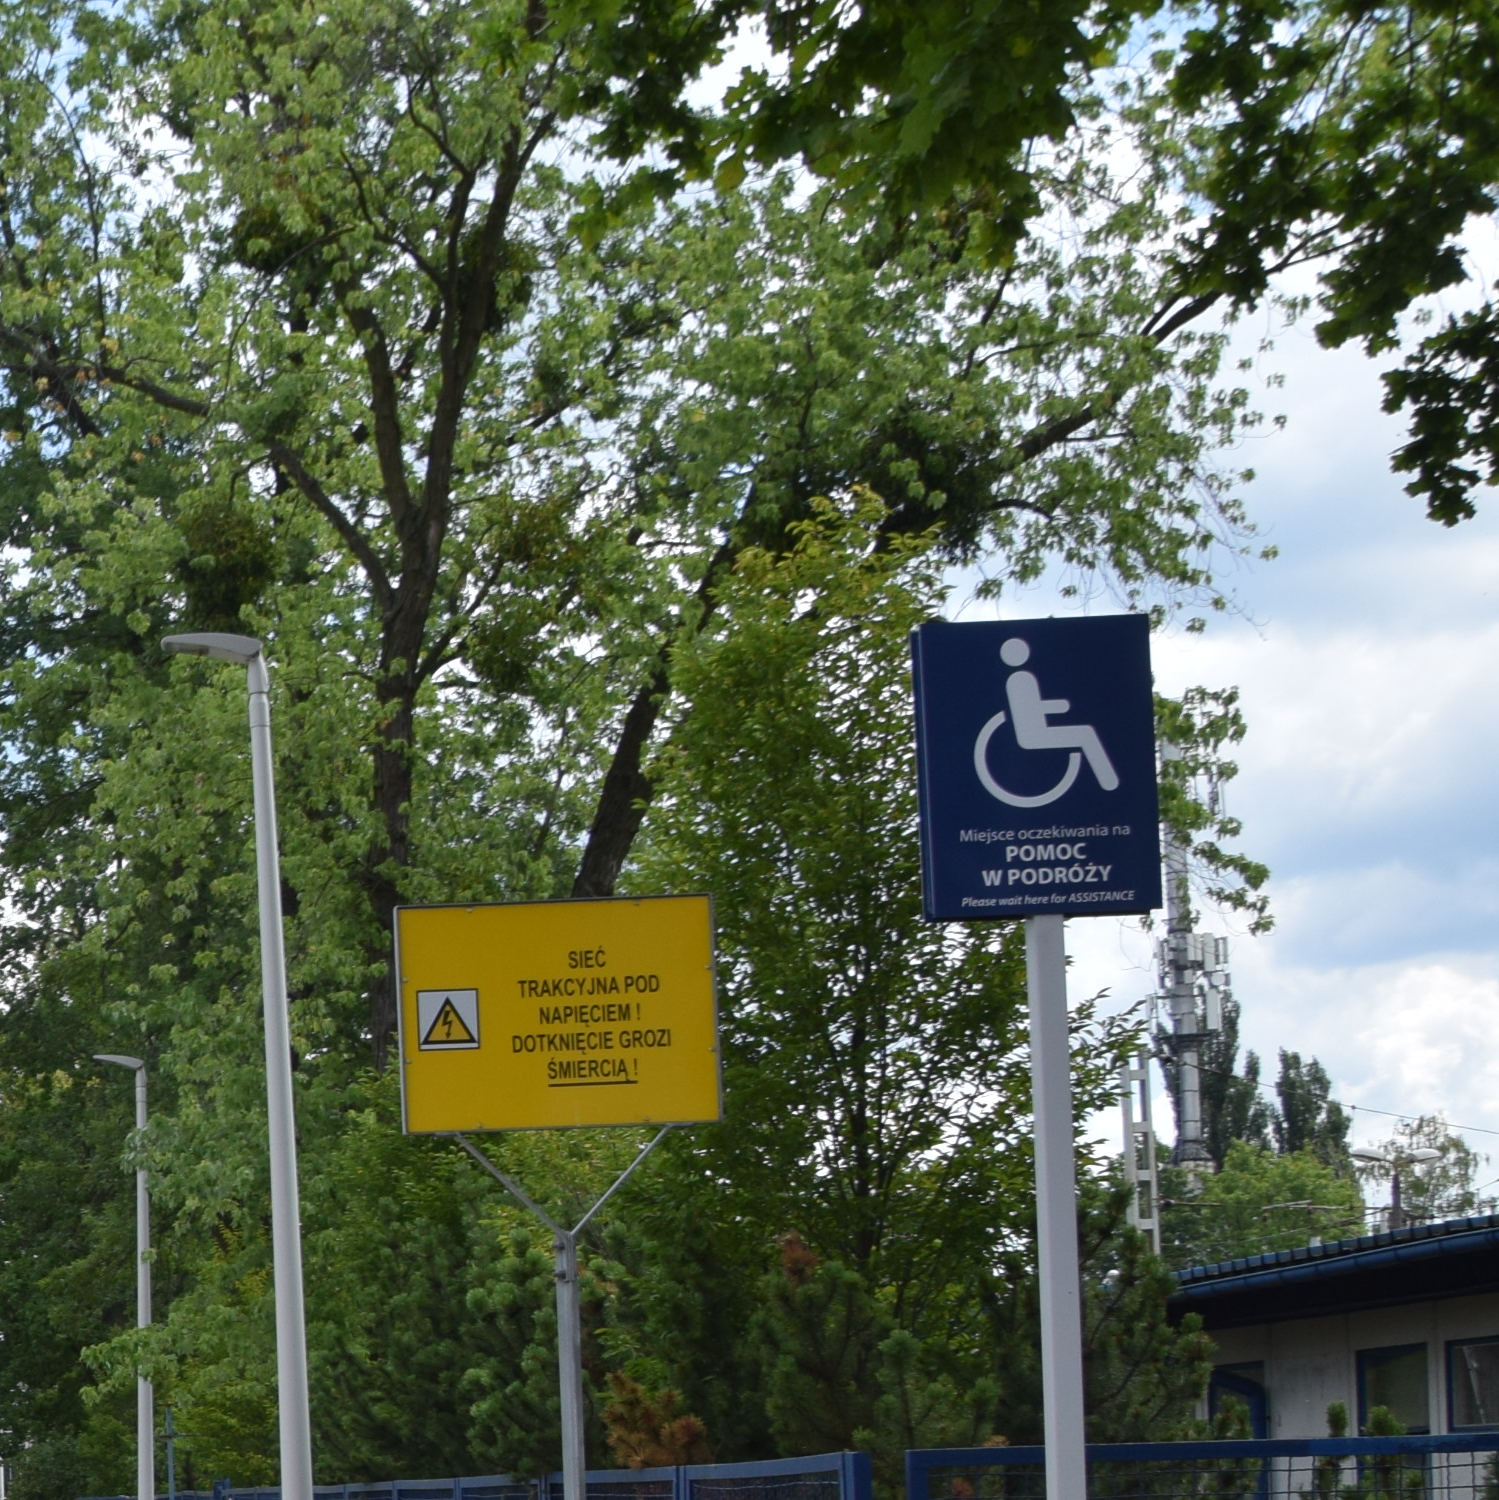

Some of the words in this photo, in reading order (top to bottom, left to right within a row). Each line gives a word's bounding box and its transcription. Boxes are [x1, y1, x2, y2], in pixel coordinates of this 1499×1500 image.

[959, 829, 1014, 844] Miejsce
[1018, 824, 1109, 840] oczekiwania
[1112, 825, 1131, 836] na
[1006, 842, 1087, 863] POMOC
[982, 869, 1002, 887] W
[1007, 862, 1112, 886] PODRÓŻY
[961, 897, 996, 908] Please
[998, 895, 1022, 906] wait
[1024, 894, 1049, 905] here
[1051, 893, 1067, 905] for
[1068, 890, 1135, 903] ASSISTANCE
[568, 945, 607, 969] SIEĆ
[517, 976, 620, 998] TRAKCYJNA
[624, 974, 660, 994] POD
[539, 1003, 631, 1028] NAPIĘCIEM
[512, 1031, 614, 1055] DOTKNIĘCIE
[619, 1029, 671, 1049] GROZI
[547, 1057, 631, 1081] ŚMIERCIĄ
